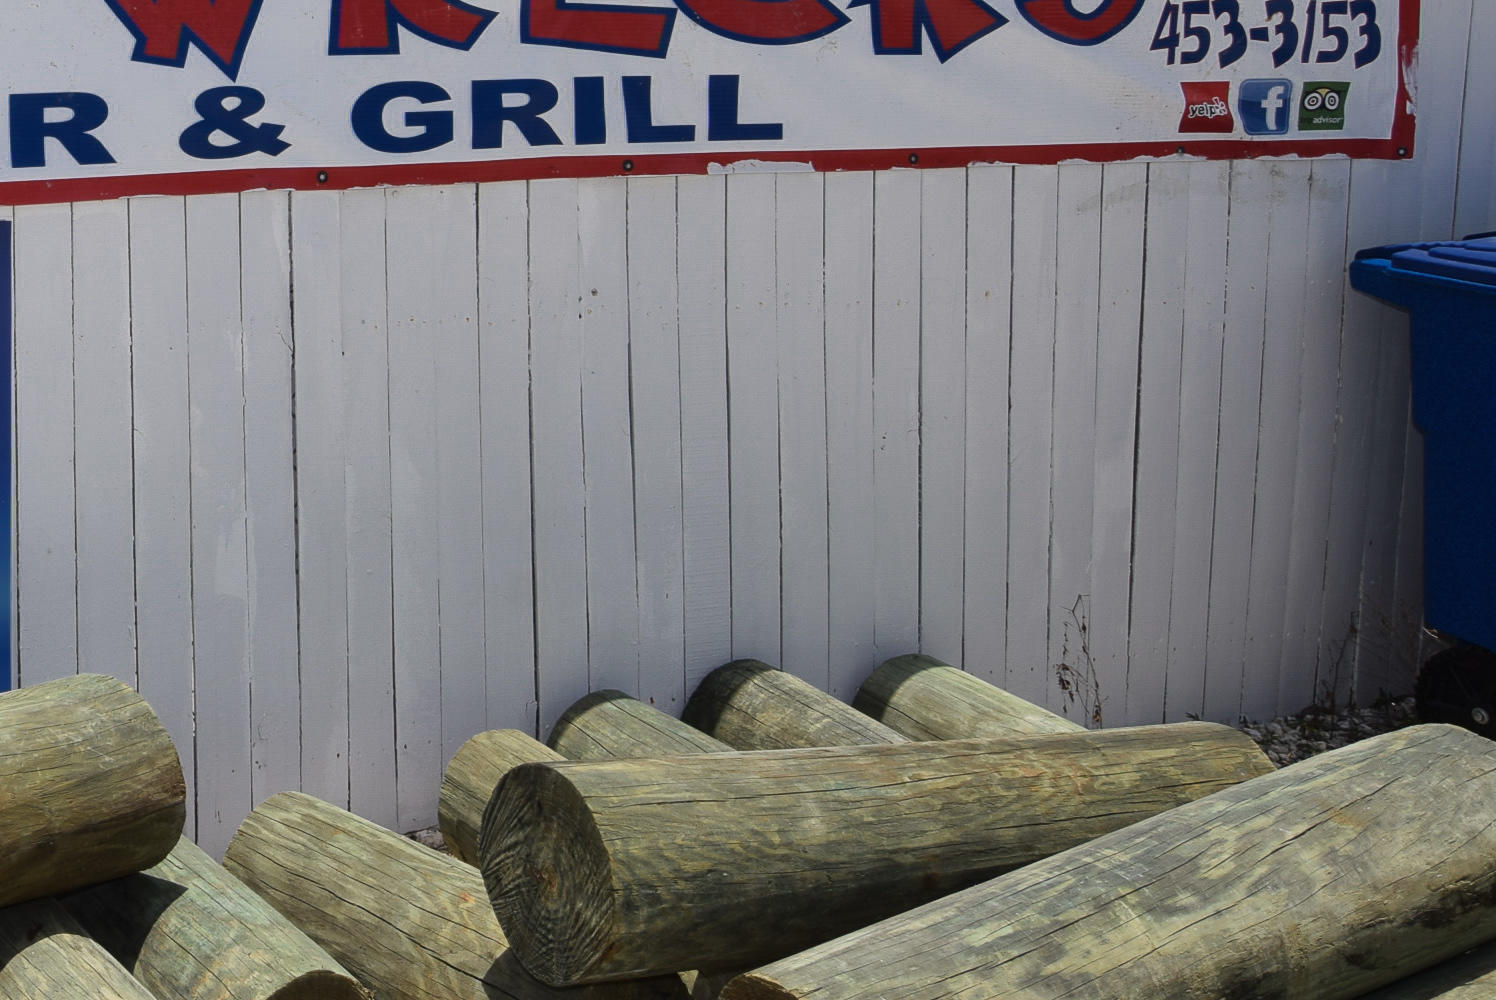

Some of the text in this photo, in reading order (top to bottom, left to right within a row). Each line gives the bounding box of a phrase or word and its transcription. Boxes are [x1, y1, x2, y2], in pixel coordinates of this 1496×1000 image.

[177, 85, 292, 160] &
[350, 74, 784, 154] GRILL
[1189, 103, 1216, 119] yelp
